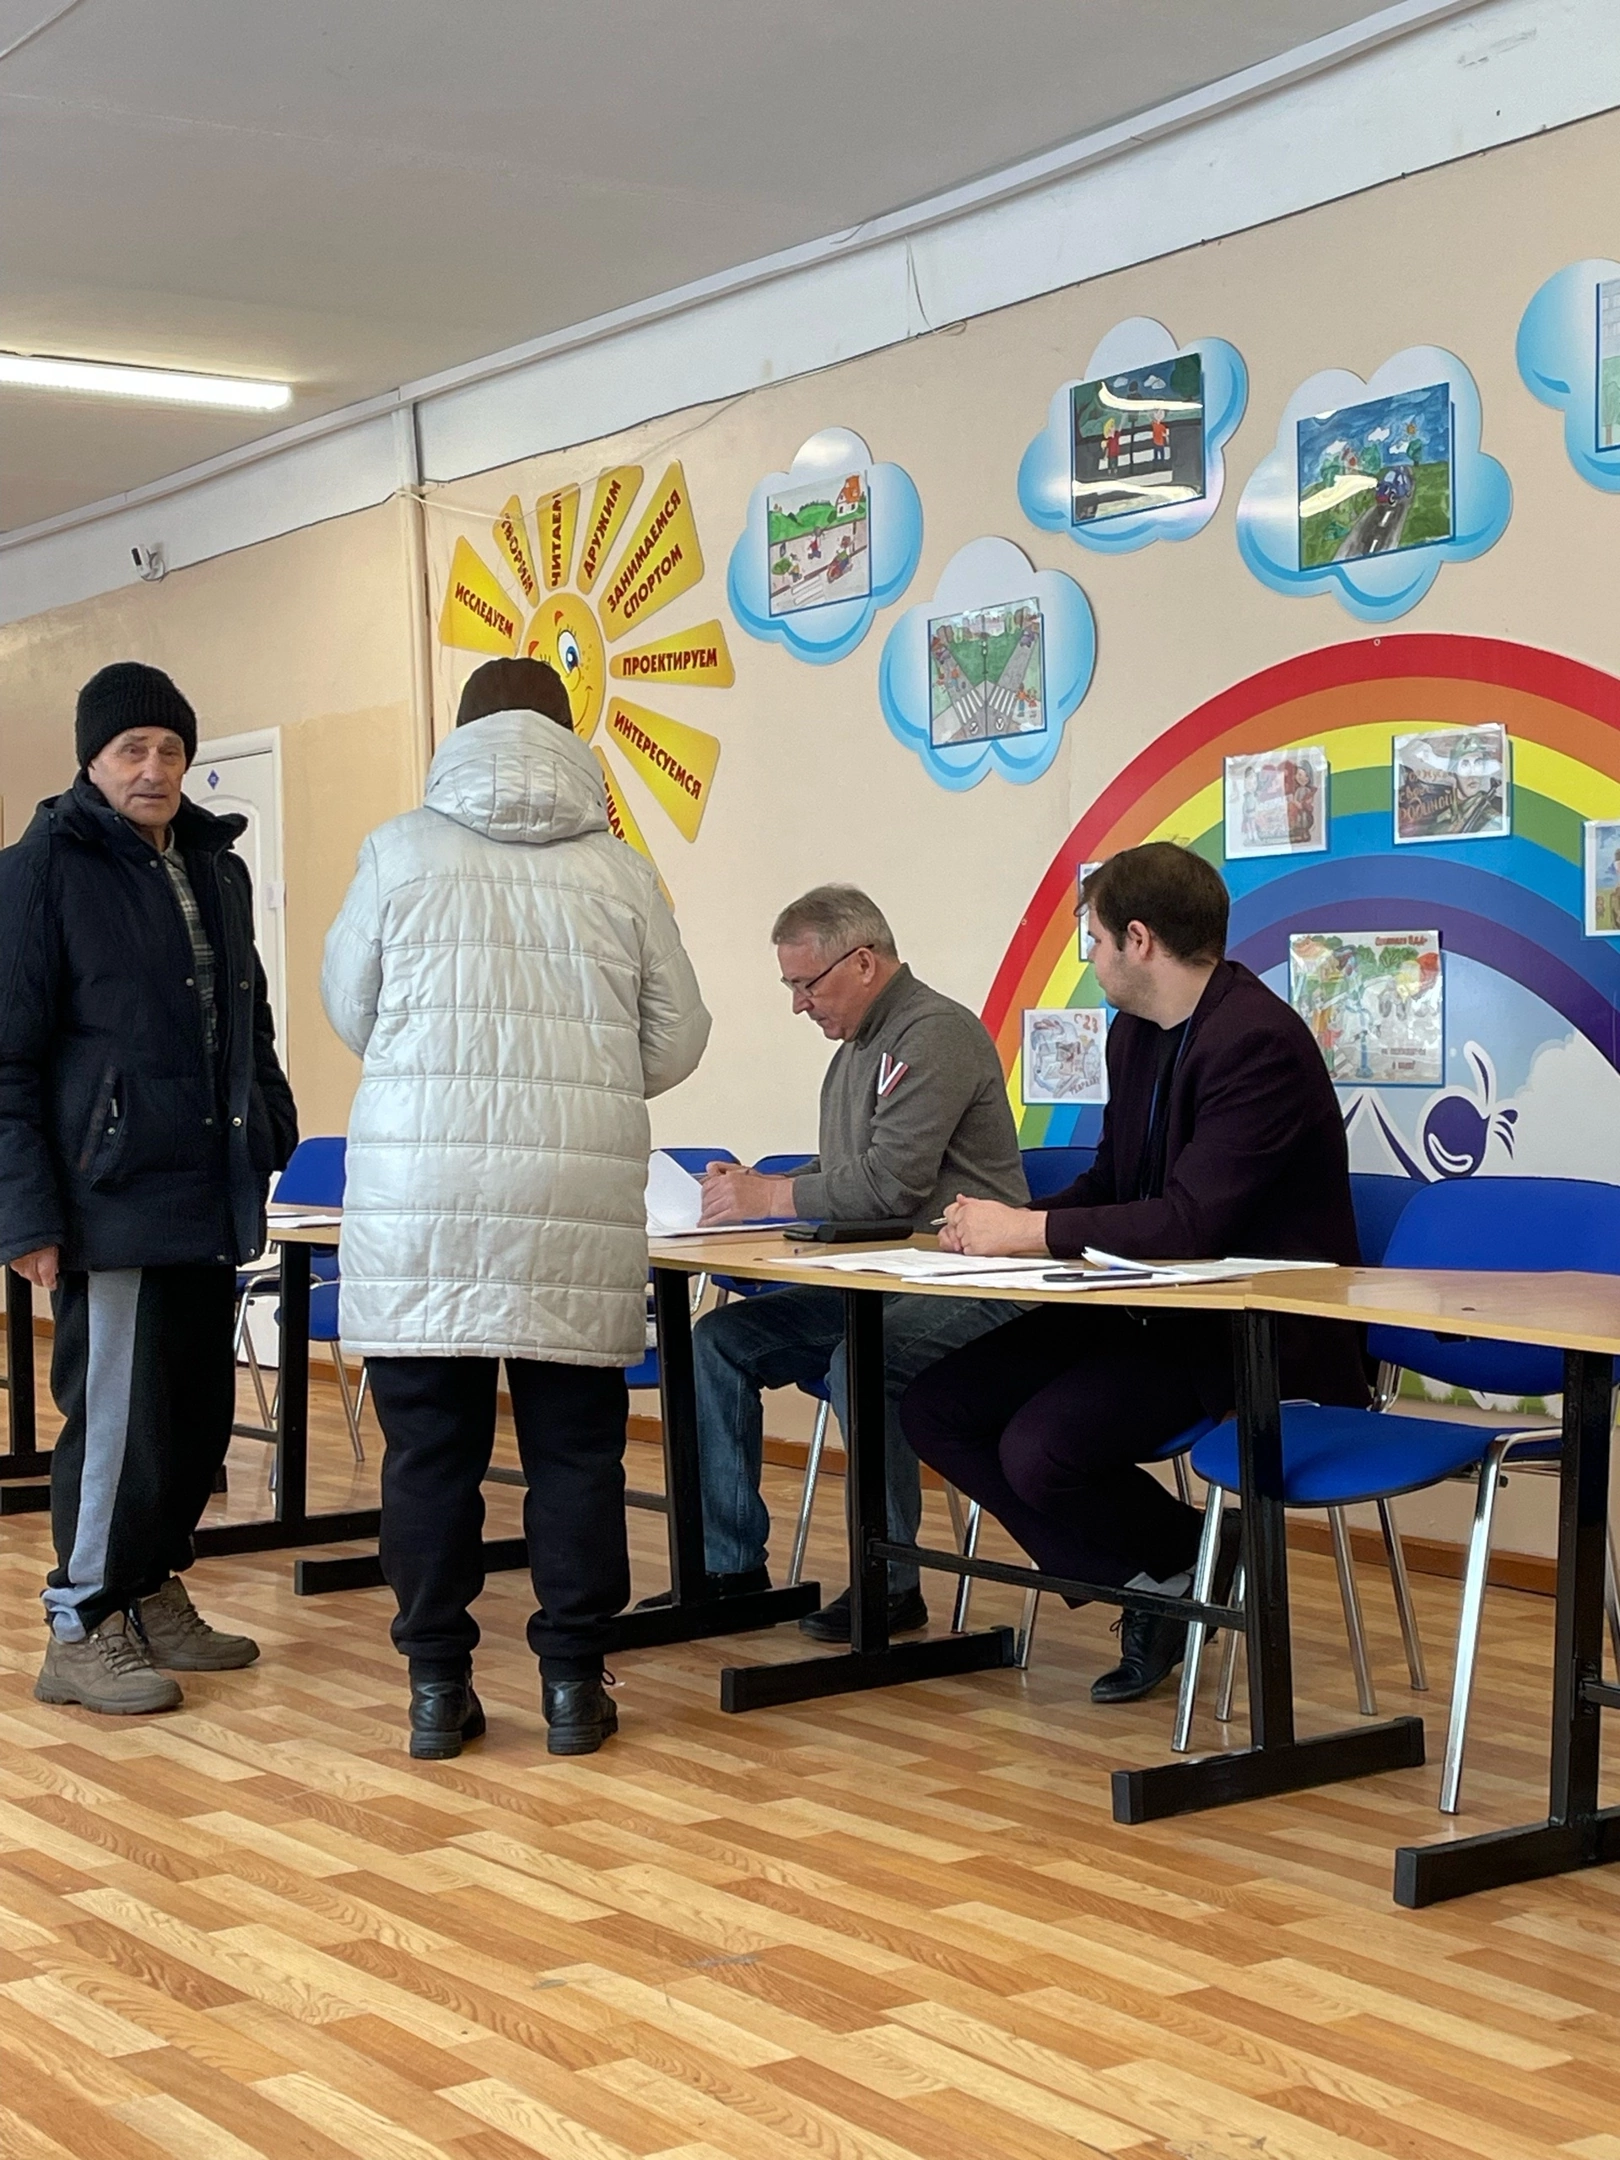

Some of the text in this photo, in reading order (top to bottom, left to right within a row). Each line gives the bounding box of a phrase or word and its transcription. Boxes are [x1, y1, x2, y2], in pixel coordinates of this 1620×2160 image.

[552, 492, 562, 587] ЧИТАЕМ
[582, 479, 622, 580] ДРУЖИМ
[606, 488, 682, 614] ЗАНИМАЕМСЯ
[454, 582, 514, 640] ИССЛЕДУЕМ
[623, 543, 683, 619] СПОРТОМ
[622, 647, 718, 676] ПРОЕКТИРУЕМ
[613, 710, 703, 801] ИНТЕРЕСУЕМСЯ
